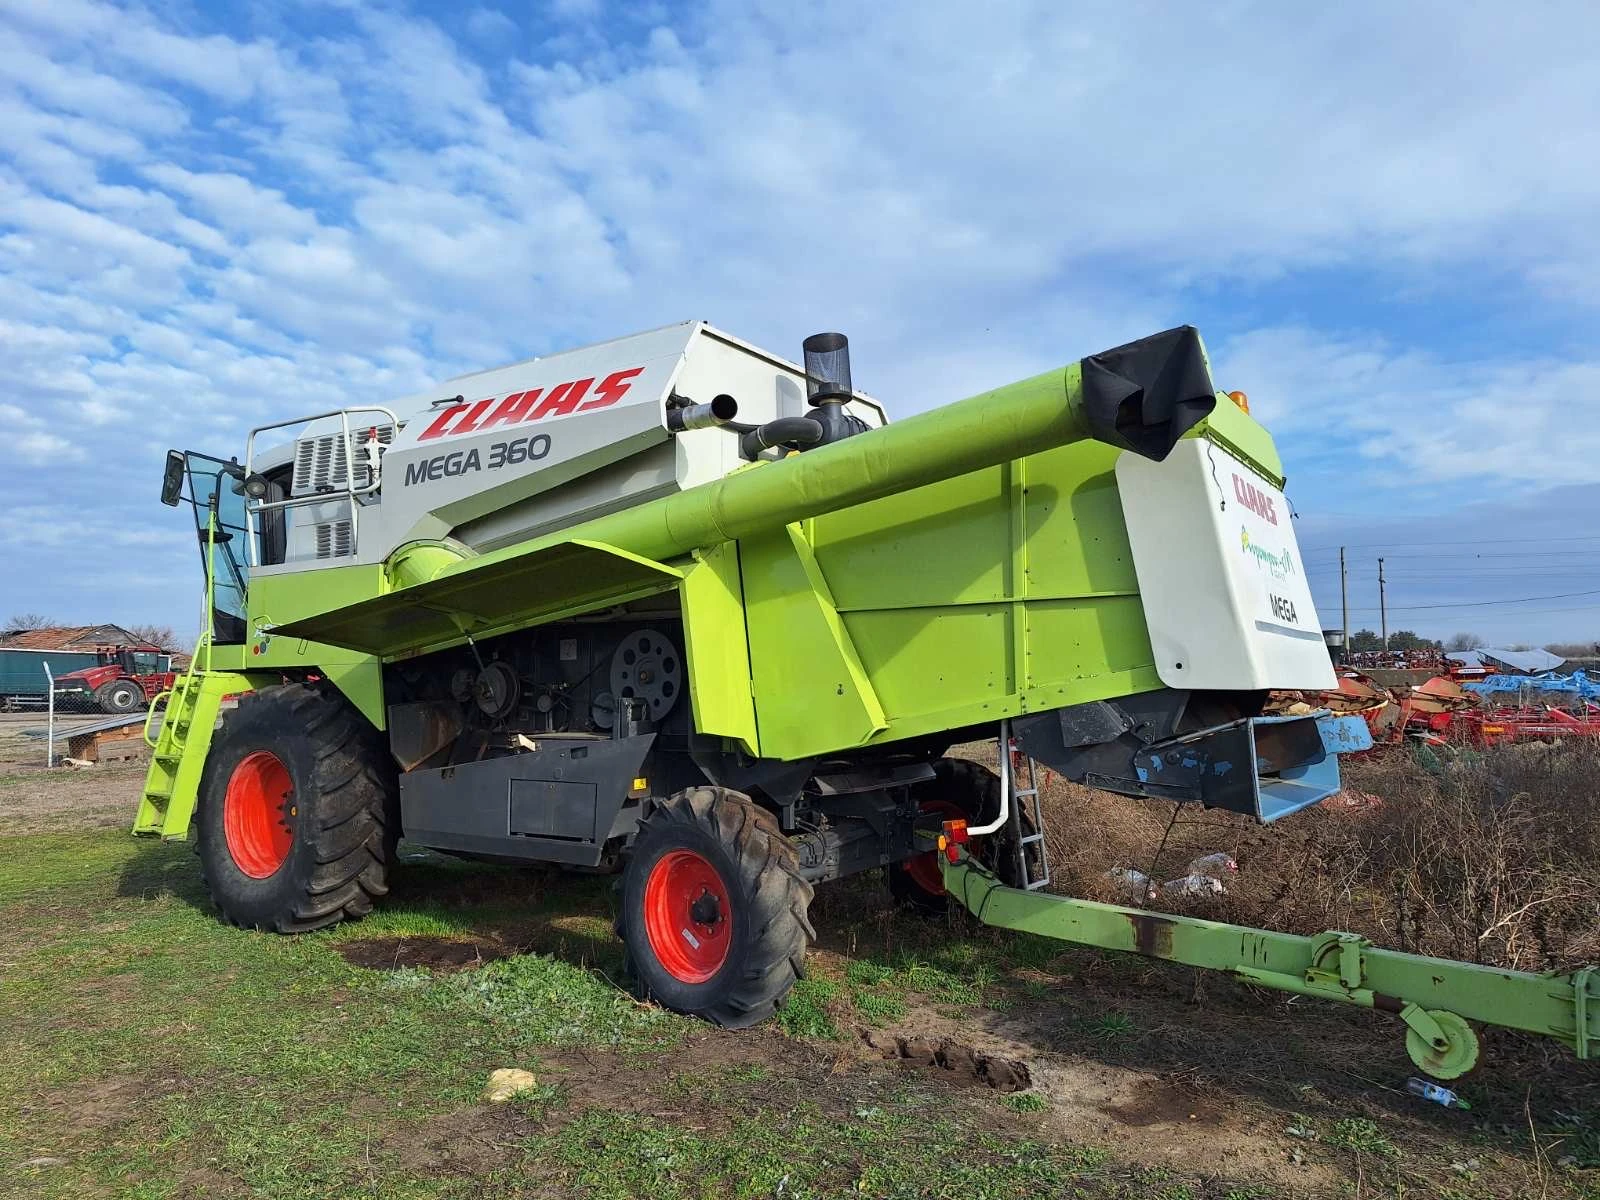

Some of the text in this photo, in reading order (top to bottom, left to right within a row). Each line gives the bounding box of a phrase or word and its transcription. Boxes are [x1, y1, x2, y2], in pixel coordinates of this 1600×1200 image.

[417, 366, 645, 442] CLAAS
[404, 433, 552, 487] MEGA 360
[1232, 472, 1278, 526] CLAAS
[1270, 593, 1299, 624] MEGA
